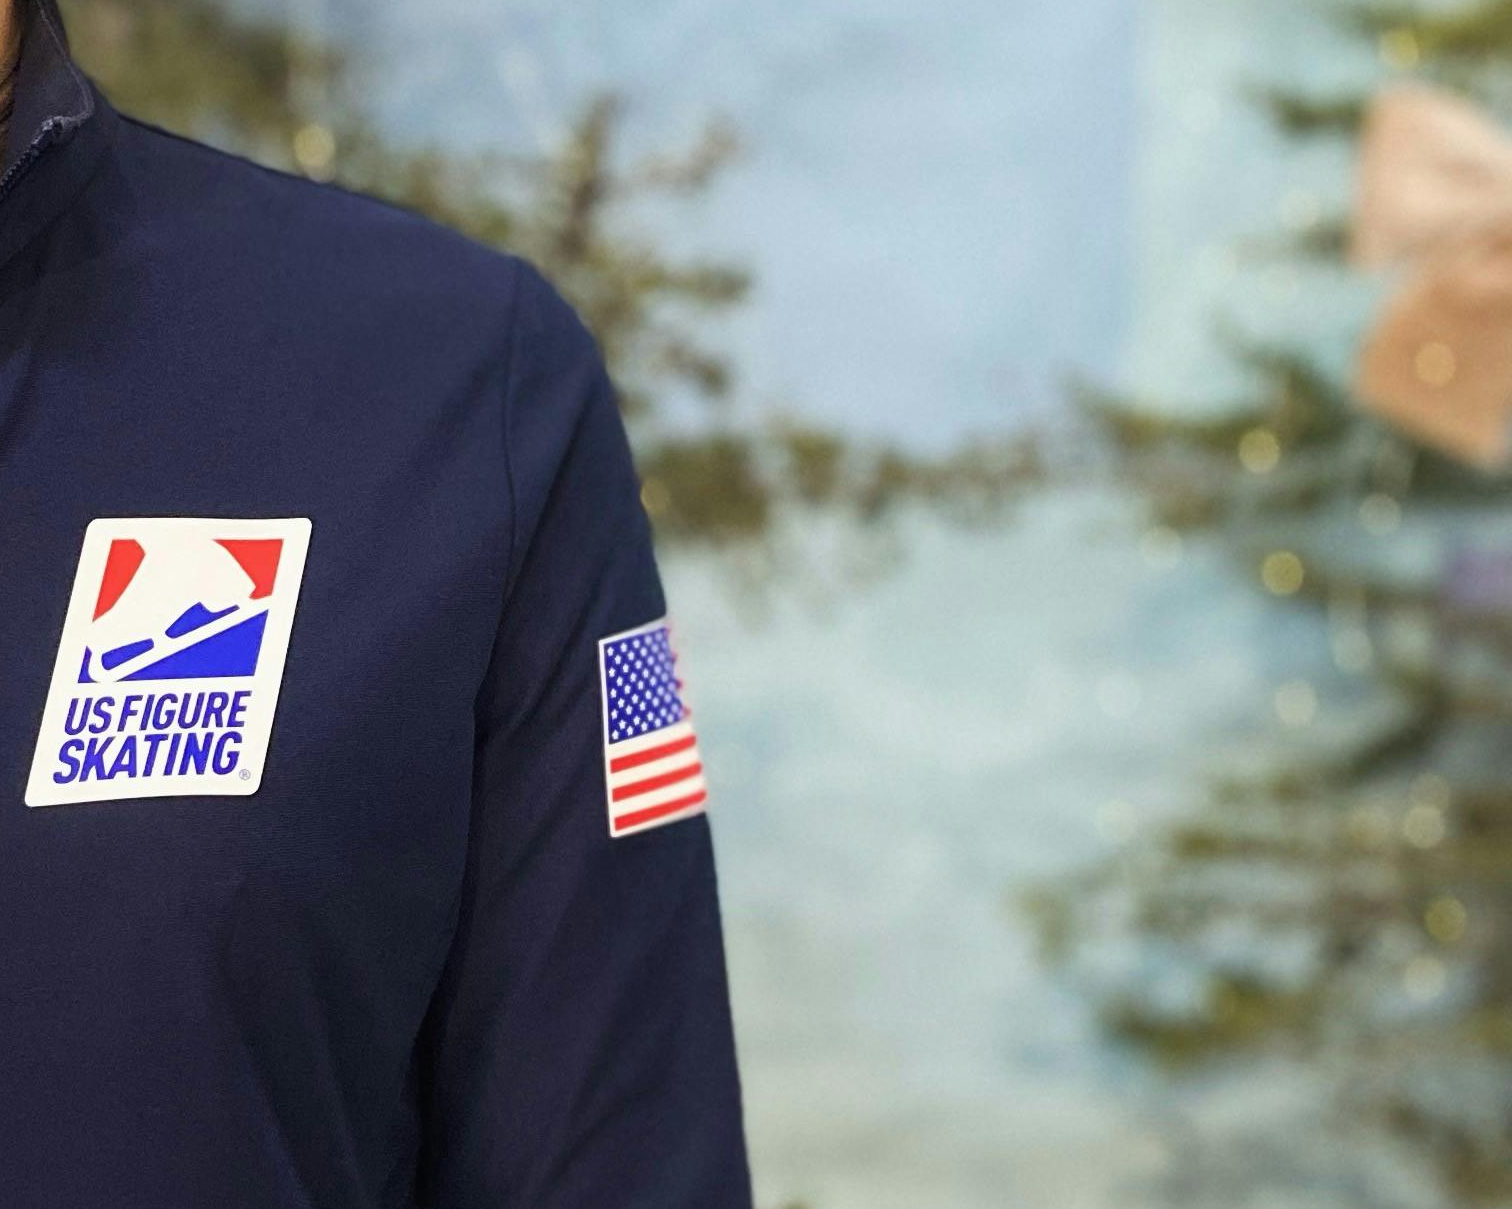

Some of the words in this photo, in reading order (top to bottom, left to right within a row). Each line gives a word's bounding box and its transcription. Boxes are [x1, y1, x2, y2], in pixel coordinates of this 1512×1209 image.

[64, 696, 116, 736] US
[117, 690, 252, 732] FIGURE
[53, 731, 243, 784] SKATING
